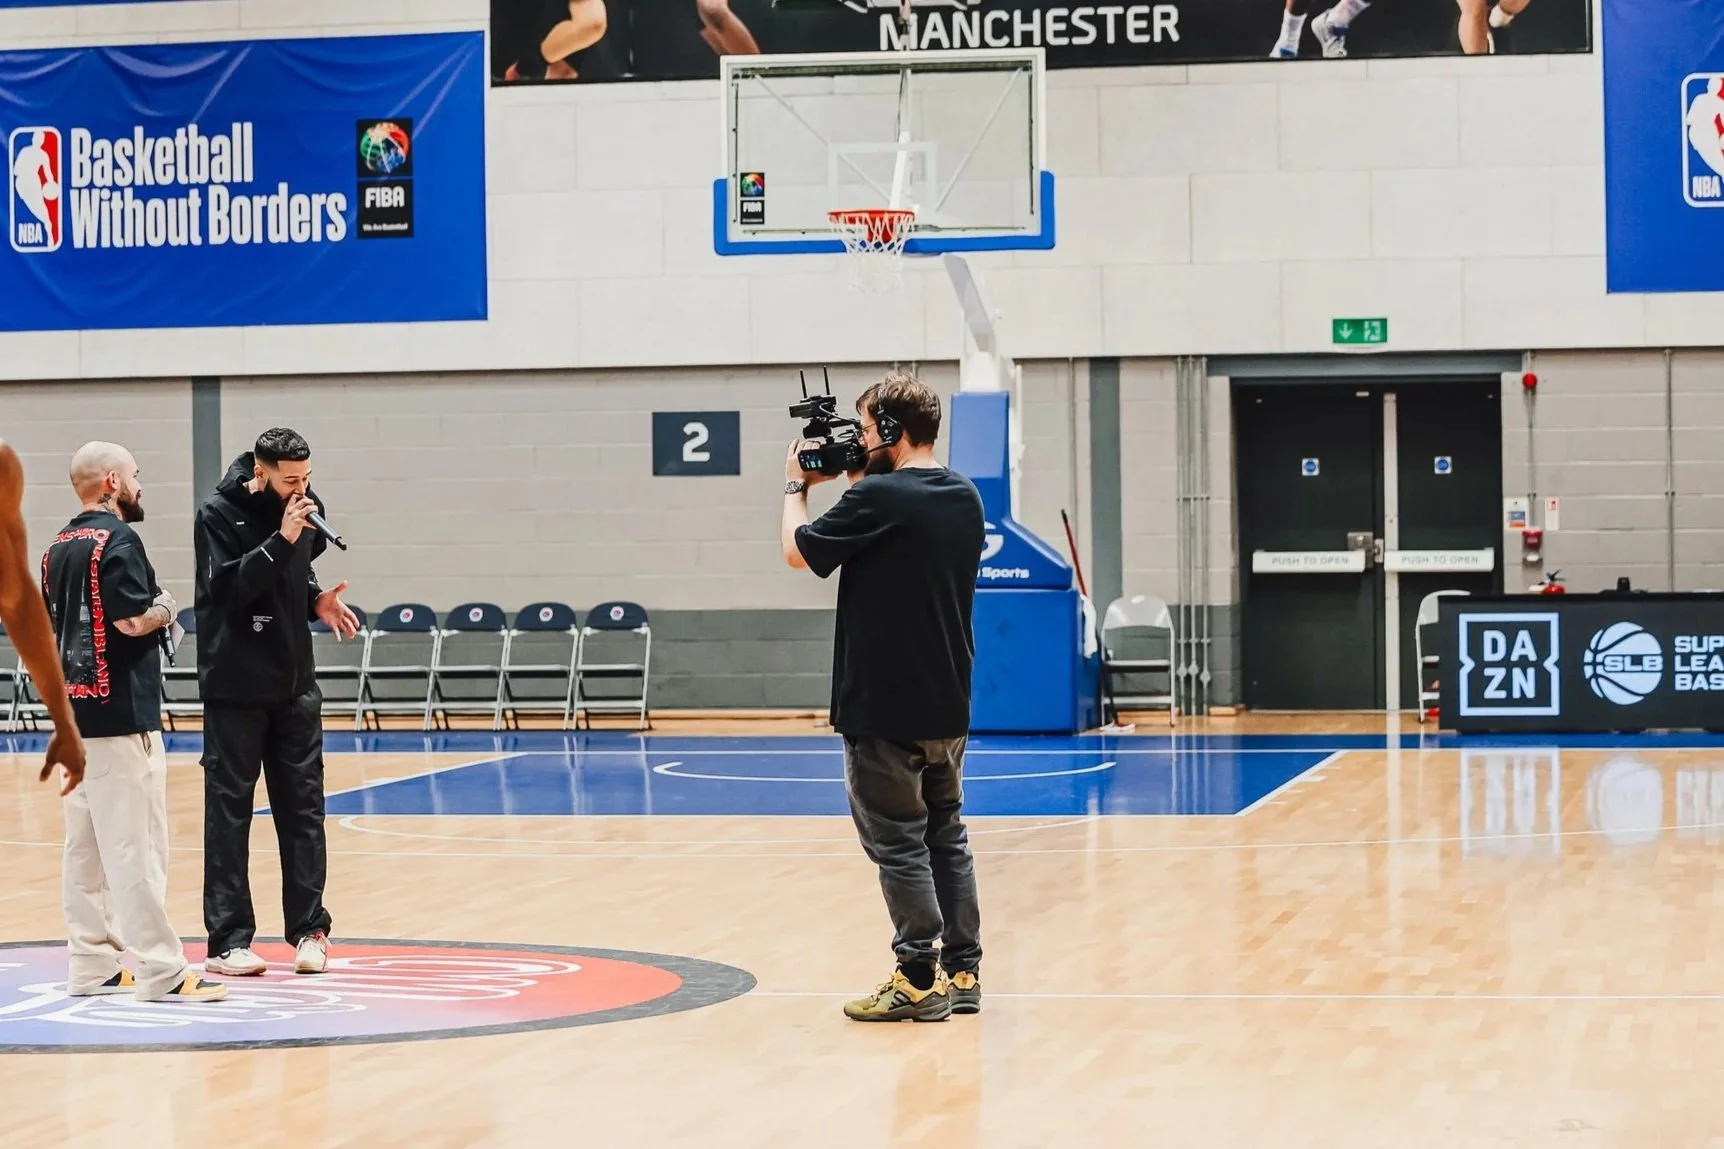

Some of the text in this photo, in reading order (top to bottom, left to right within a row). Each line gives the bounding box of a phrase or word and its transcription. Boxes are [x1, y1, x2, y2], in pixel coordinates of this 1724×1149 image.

[879, 4, 1181, 51] MANCHESTER
[70, 121, 254, 188] Basketball
[365, 186, 405, 208] FIBA
[1692, 175, 1721, 199] NBA
[69, 182, 347, 249] Without Borders
[18, 222, 44, 245] NBA
[682, 421, 711, 462] 2
[1271, 556, 1350, 566] PUSH TO OPEN
[1401, 555, 1479, 565] PUSH TO OPEN
[981, 566, 1030, 580] Sports
[1603, 655, 1663, 672] SLB
